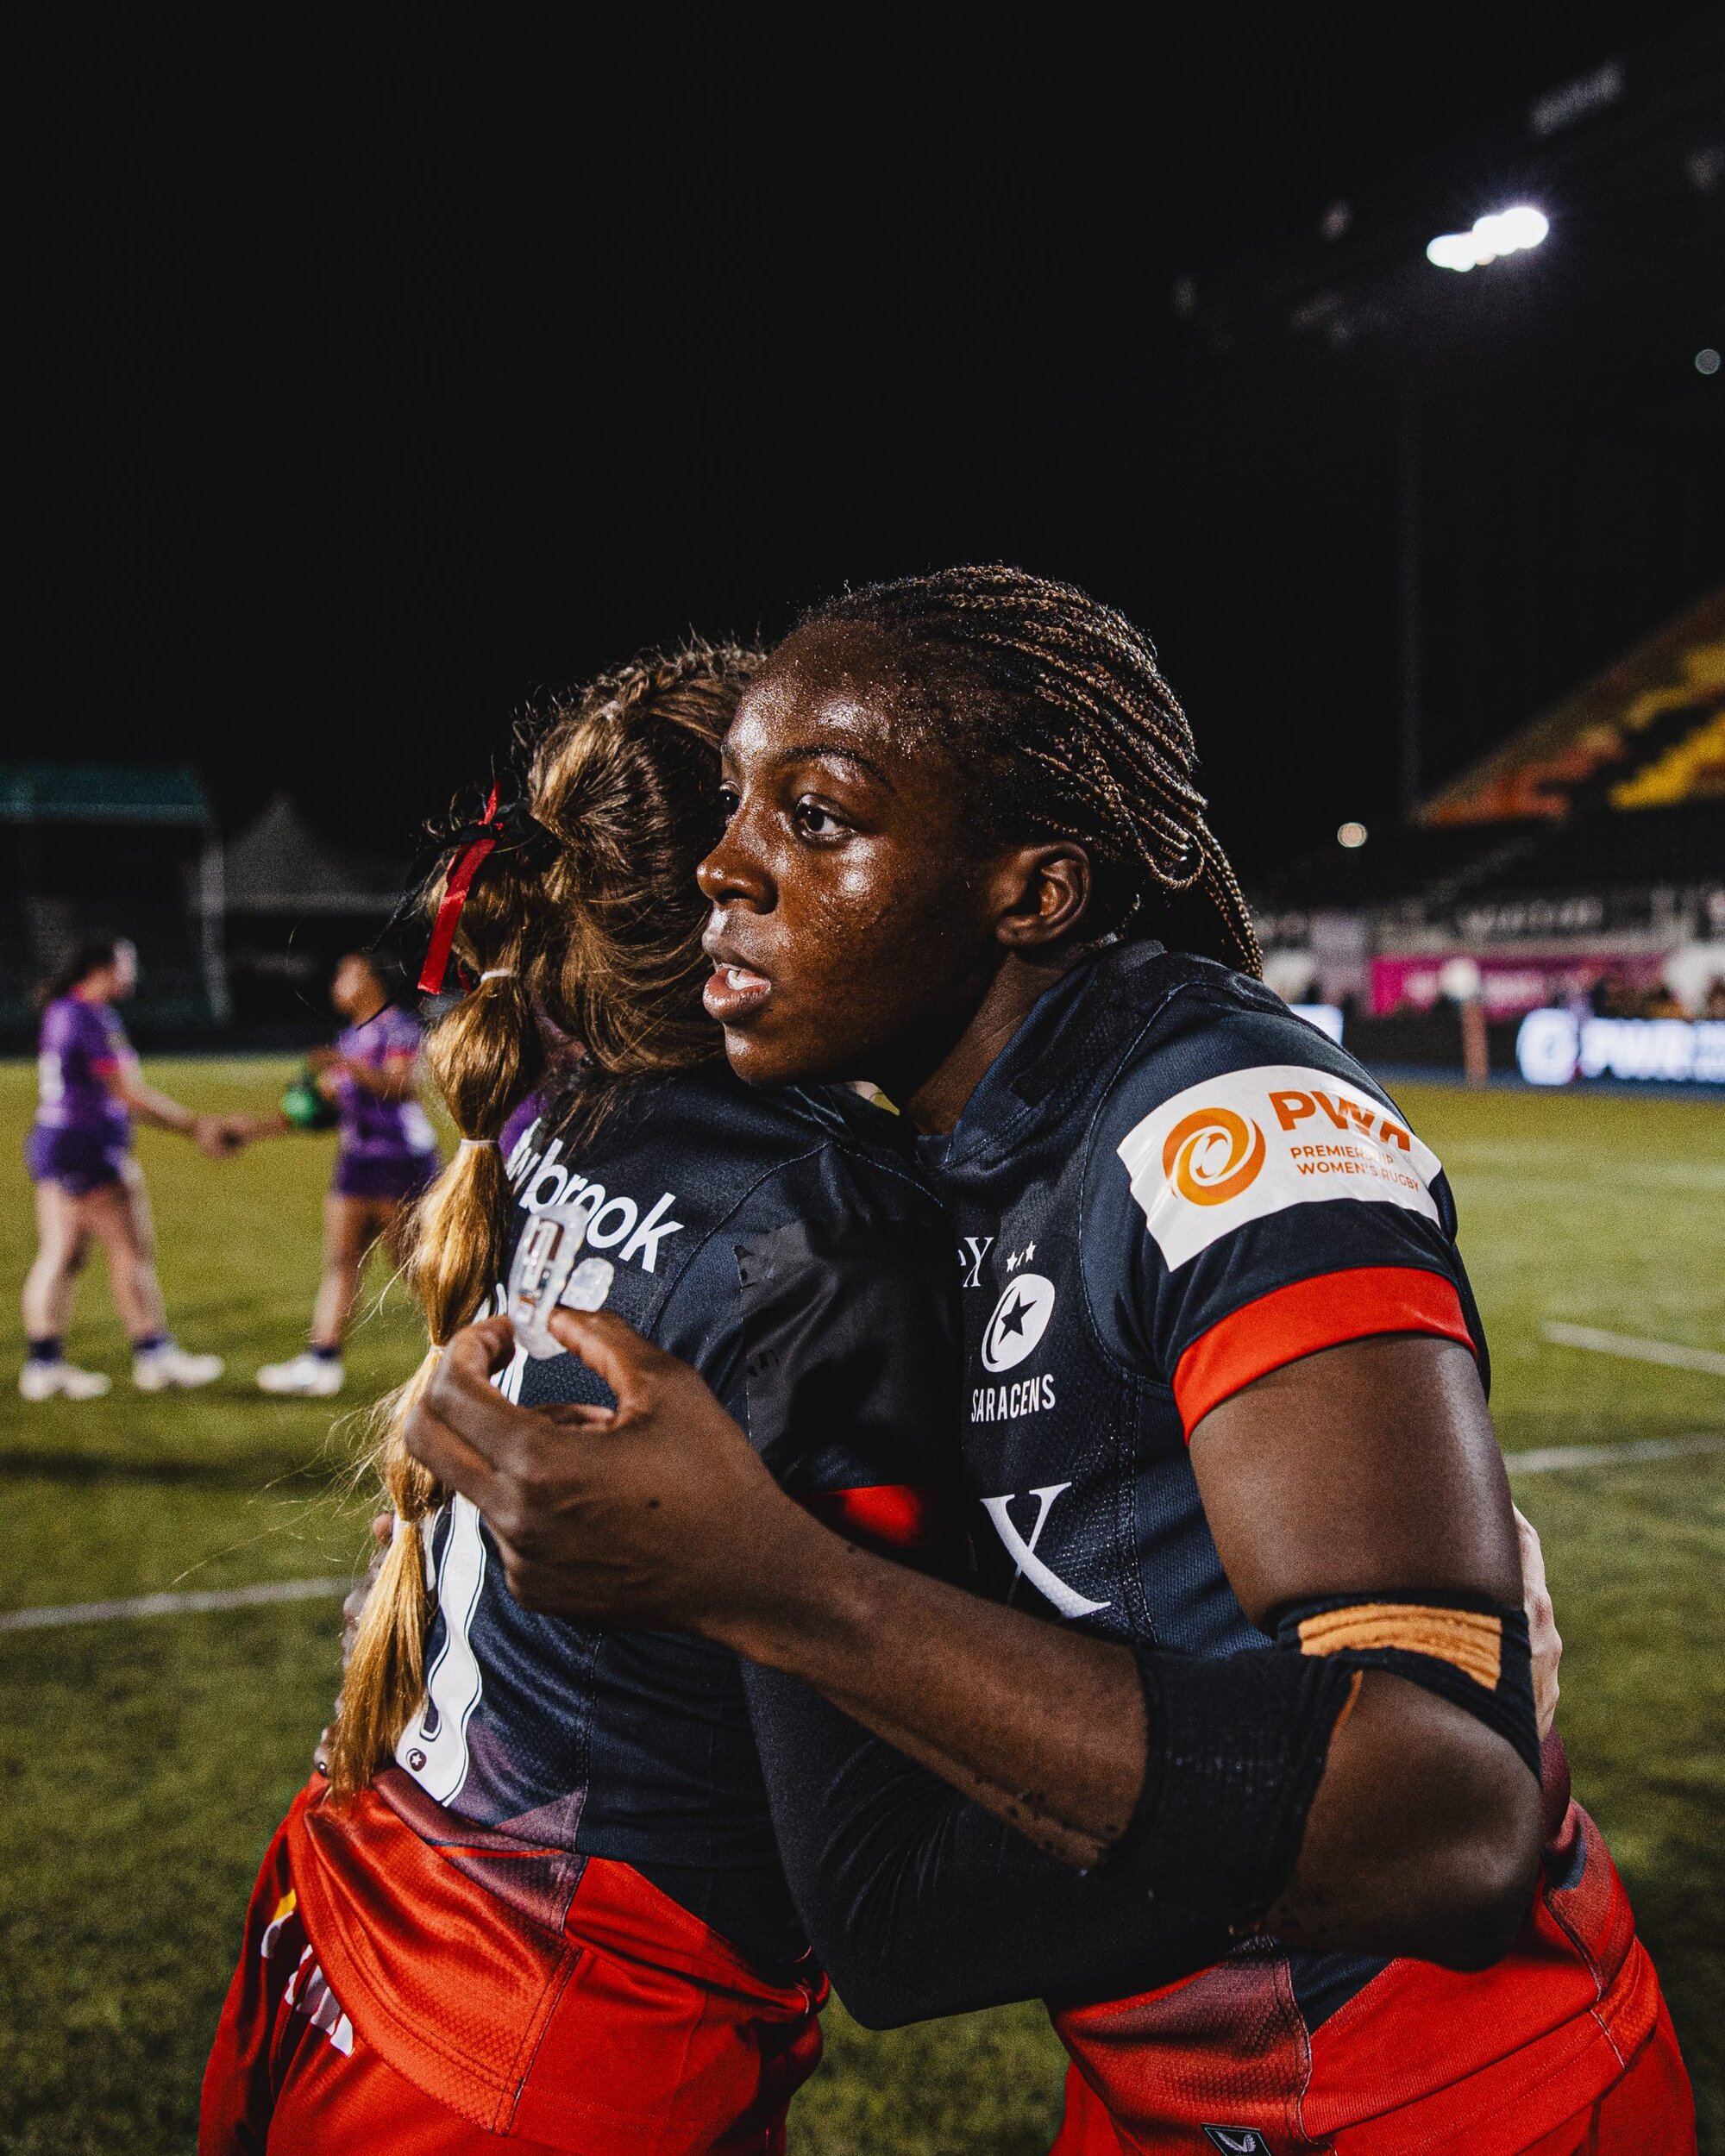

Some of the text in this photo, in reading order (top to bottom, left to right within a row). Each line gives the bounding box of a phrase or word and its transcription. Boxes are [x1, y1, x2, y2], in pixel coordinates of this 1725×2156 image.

[1289, 1144, 1394, 1165] PREMIERIP
[1296, 1161, 1421, 1192] WOMEN'S RUGBY
[971, 1374, 1056, 1423] SARACENS
